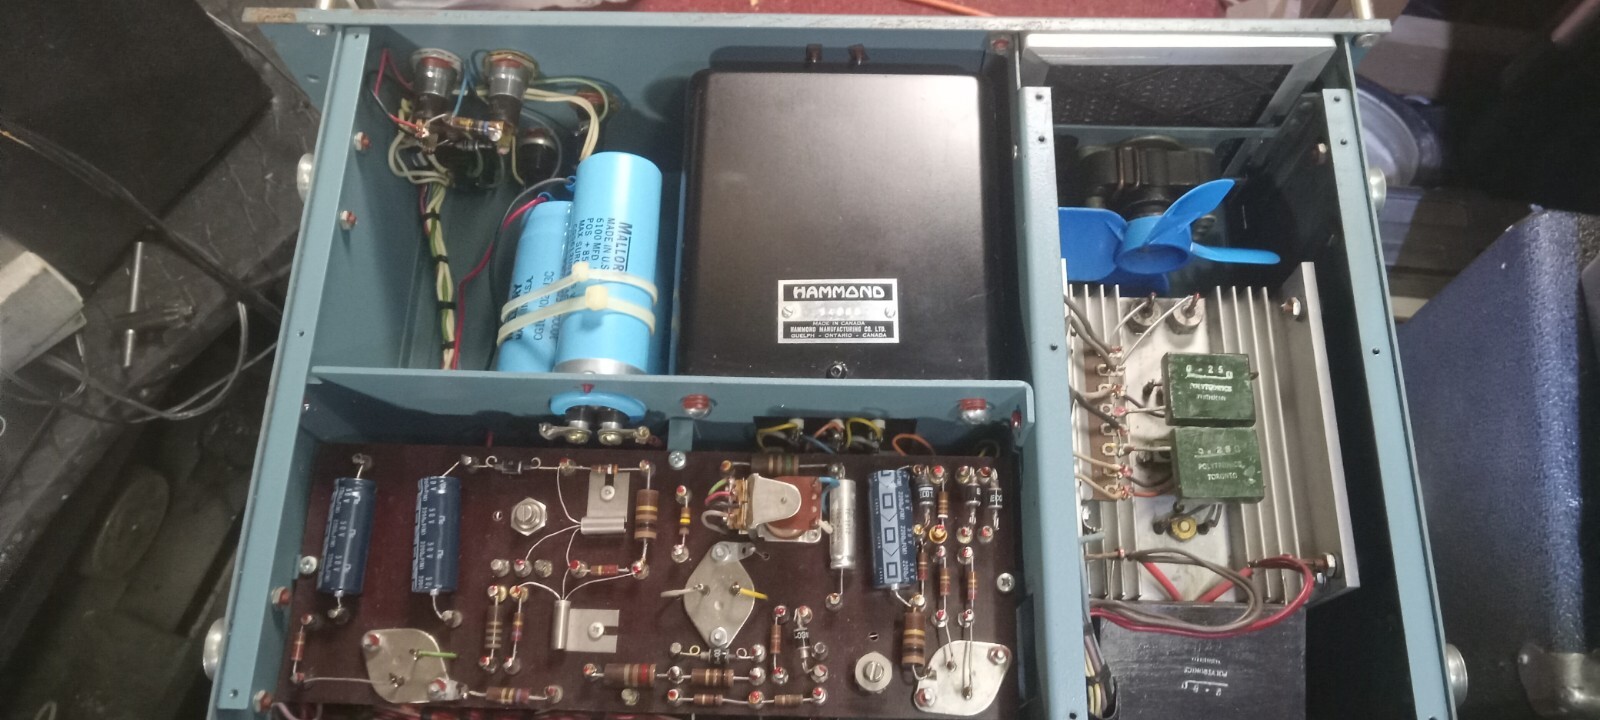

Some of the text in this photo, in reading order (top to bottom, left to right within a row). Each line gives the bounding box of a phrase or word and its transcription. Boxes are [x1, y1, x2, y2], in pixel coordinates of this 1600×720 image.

[577, 220, 585, 238] MAX
[585, 218, 594, 236] POS
[591, 218, 604, 260] 6100 MFD
[601, 218, 615, 270] MADE IN U.S
[613, 222, 633, 271] MALLOR
[793, 286, 885, 298] HAMMOND
